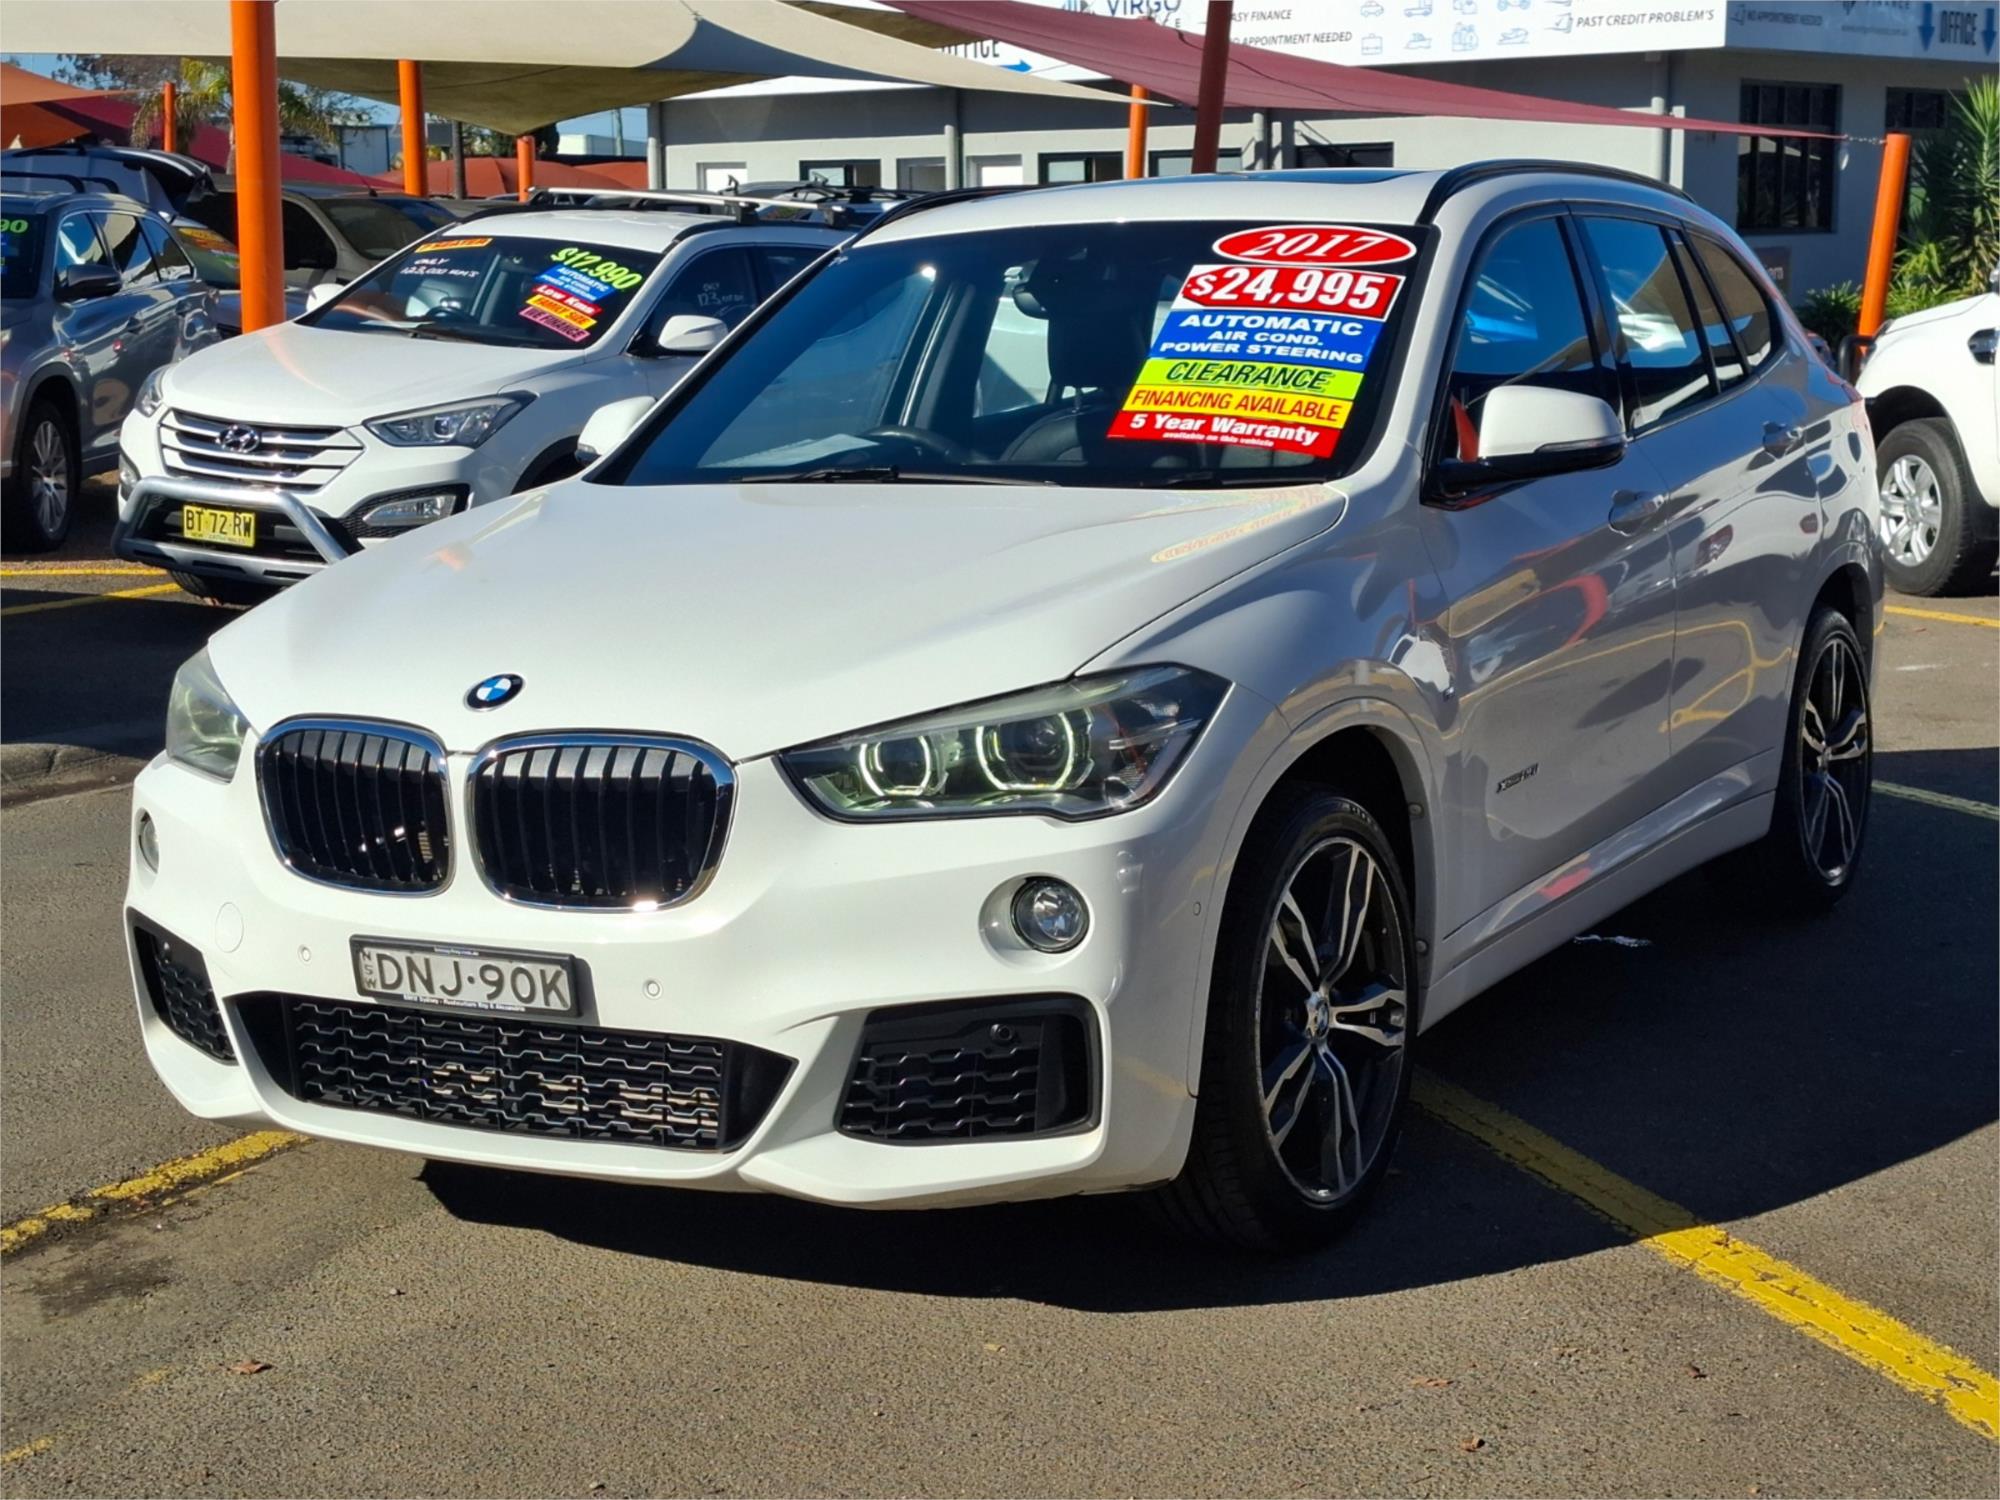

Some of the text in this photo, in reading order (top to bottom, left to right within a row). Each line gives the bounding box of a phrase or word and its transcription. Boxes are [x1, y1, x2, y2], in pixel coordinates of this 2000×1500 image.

[1231, 10, 1292, 22] ASY FINANCE
[1576, 9, 1715, 28] PAST CREDIT PROBLEM'S
[1939, 10, 1978, 46] OFFICE
[1242, 33, 1311, 46] APPOINTMENT
[1313, 31, 1352, 43] NEEDED
[1238, 233, 1390, 259] 2017
[1191, 267, 1386, 310] $24,995
[540, 313, 586, 337] FINANCE
[1179, 314, 1364, 336] AUTOMATIC
[1208, 330, 1324, 345] AIR COND.
[1160, 342, 1364, 364] POWER STEERING
[1166, 361, 1335, 391] CLEARANCE
[1131, 389, 1343, 422] FINANCING AVAILABLE
[1130, 413, 1320, 446] 5 Year Warranty
